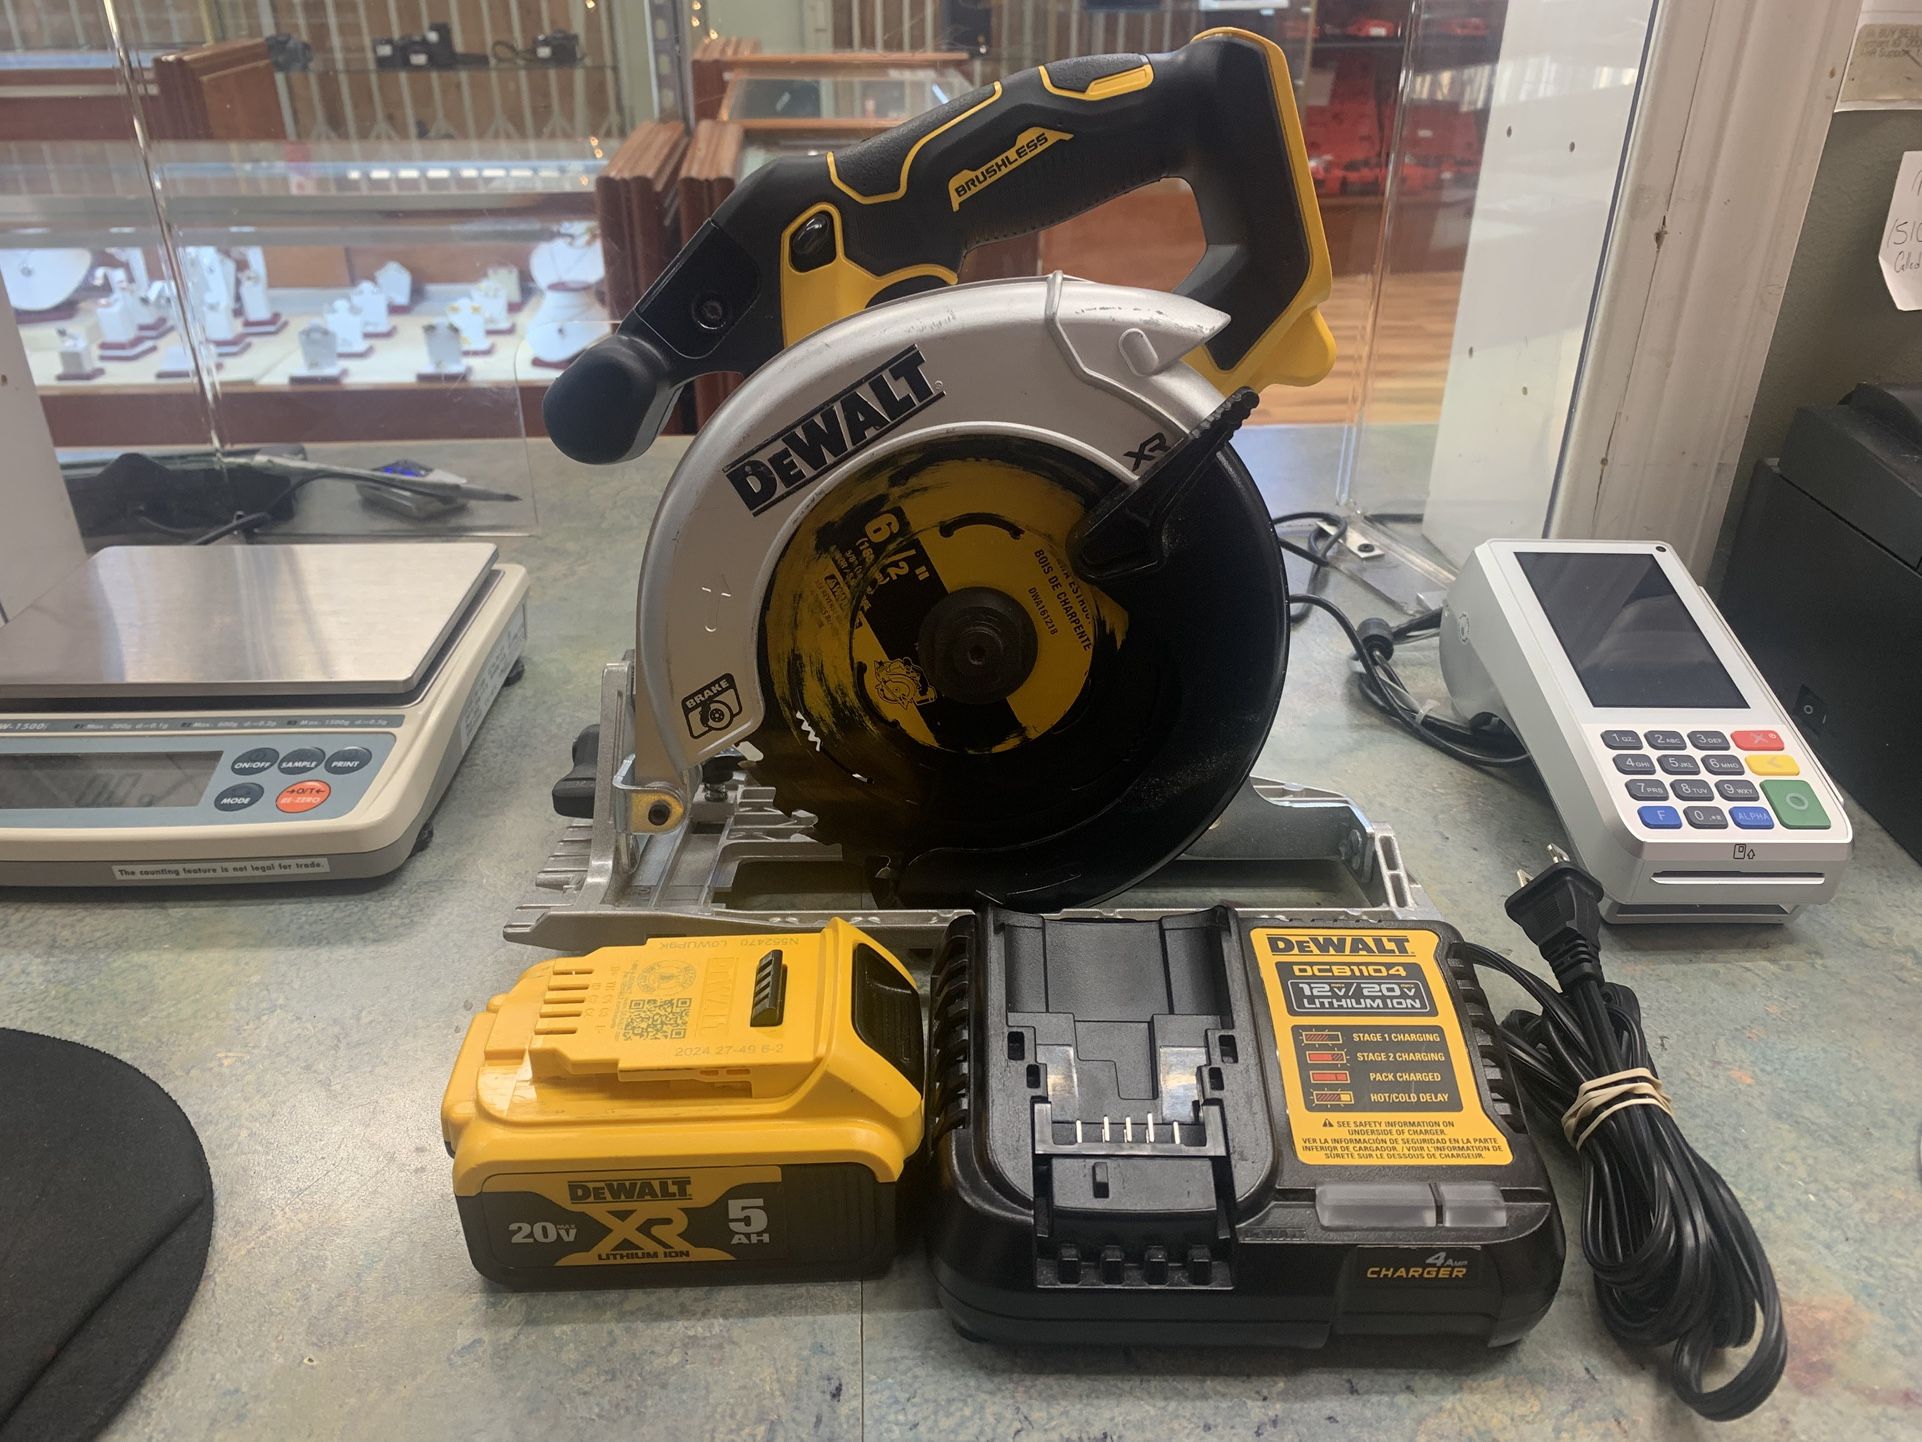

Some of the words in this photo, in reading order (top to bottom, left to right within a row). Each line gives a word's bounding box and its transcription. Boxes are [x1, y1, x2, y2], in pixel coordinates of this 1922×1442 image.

[955, 133, 1048, 197] BRUSHLESS
[1123, 432, 1171, 472] XR
[1034, 549, 1053, 575] BOIS
[1048, 575, 1062, 591] DE
[1056, 591, 1093, 651] CHARPENTE
[686, 679, 729, 708] BRAKE
[1612, 733, 1620, 742] 1
[1654, 734, 1665, 743] 2
[1696, 734, 1707, 743] 3
[281, 761, 318, 769] SAMPLE
[1626, 758, 1635, 767] 4
[1668, 757, 1679, 767] 5
[1709, 758, 1720, 768] 6
[1636, 783, 1645, 793] 7
[1681, 783, 1691, 794] 8
[1724, 784, 1735, 794] 9
[220, 797, 252, 805] MODE
[1657, 810, 1666, 821] F
[1694, 810, 1704, 821] 0
[1738, 811, 1769, 821] ALPHA
[118, 868, 136, 877] The
[140, 868, 180, 877] counting
[183, 866, 217, 875] feature
[220, 865, 229, 873] is
[232, 864, 248, 873] not
[251, 863, 275, 873] legal
[278, 863, 292, 871] for
[296, 861, 325, 870] trade.
[1292, 965, 1406, 977] DCB1104
[1304, 998, 1384, 1008] LITHIUM
[1388, 999, 1421, 1009] ION
[1352, 1033, 1382, 1041] STAGE
[1391, 1033, 1440, 1042] CHARGING
[1357, 1052, 1387, 1061] STAGE
[1388, 1052, 1395, 1061] 2
[1396, 1052, 1445, 1061] CHARGING
[1369, 1072, 1395, 1081] PACK
[1396, 1072, 1441, 1081] CHARGED
[1370, 1093, 1417, 1103] HOT/COLD
[1420, 1093, 1449, 1102] DELAY
[1337, 1120, 1352, 1128] SEE
[1353, 1120, 1382, 1128] SAFETY
[1385, 1120, 1440, 1128] INFORMATION
[1442, 1120, 1455, 1128] ON
[1348, 1128, 1394, 1136] UNDERSIDE
[1396, 1128, 1406, 1136] OF
[1302, 1137, 1318, 1145] VER
[1319, 1137, 1329, 1145] LA
[1331, 1136, 1388, 1145] INFORMACIÓN
[1389, 1137, 1400, 1145] DE
[1401, 1137, 1447, 1145] SEGURIDAD
[1449, 1137, 1460, 1145] EN
[1462, 1137, 1472, 1145] LA
[1473, 1137, 1498, 1145] PARTE
[728, 1198, 768, 1234] 5
[584, 1207, 697, 1251] XR
[731, 1234, 770, 1245] AH
[598, 1251, 659, 1261] LITHIUM
[663, 1250, 690, 1259] ION
[1366, 1267, 1467, 1278] CHARGER
